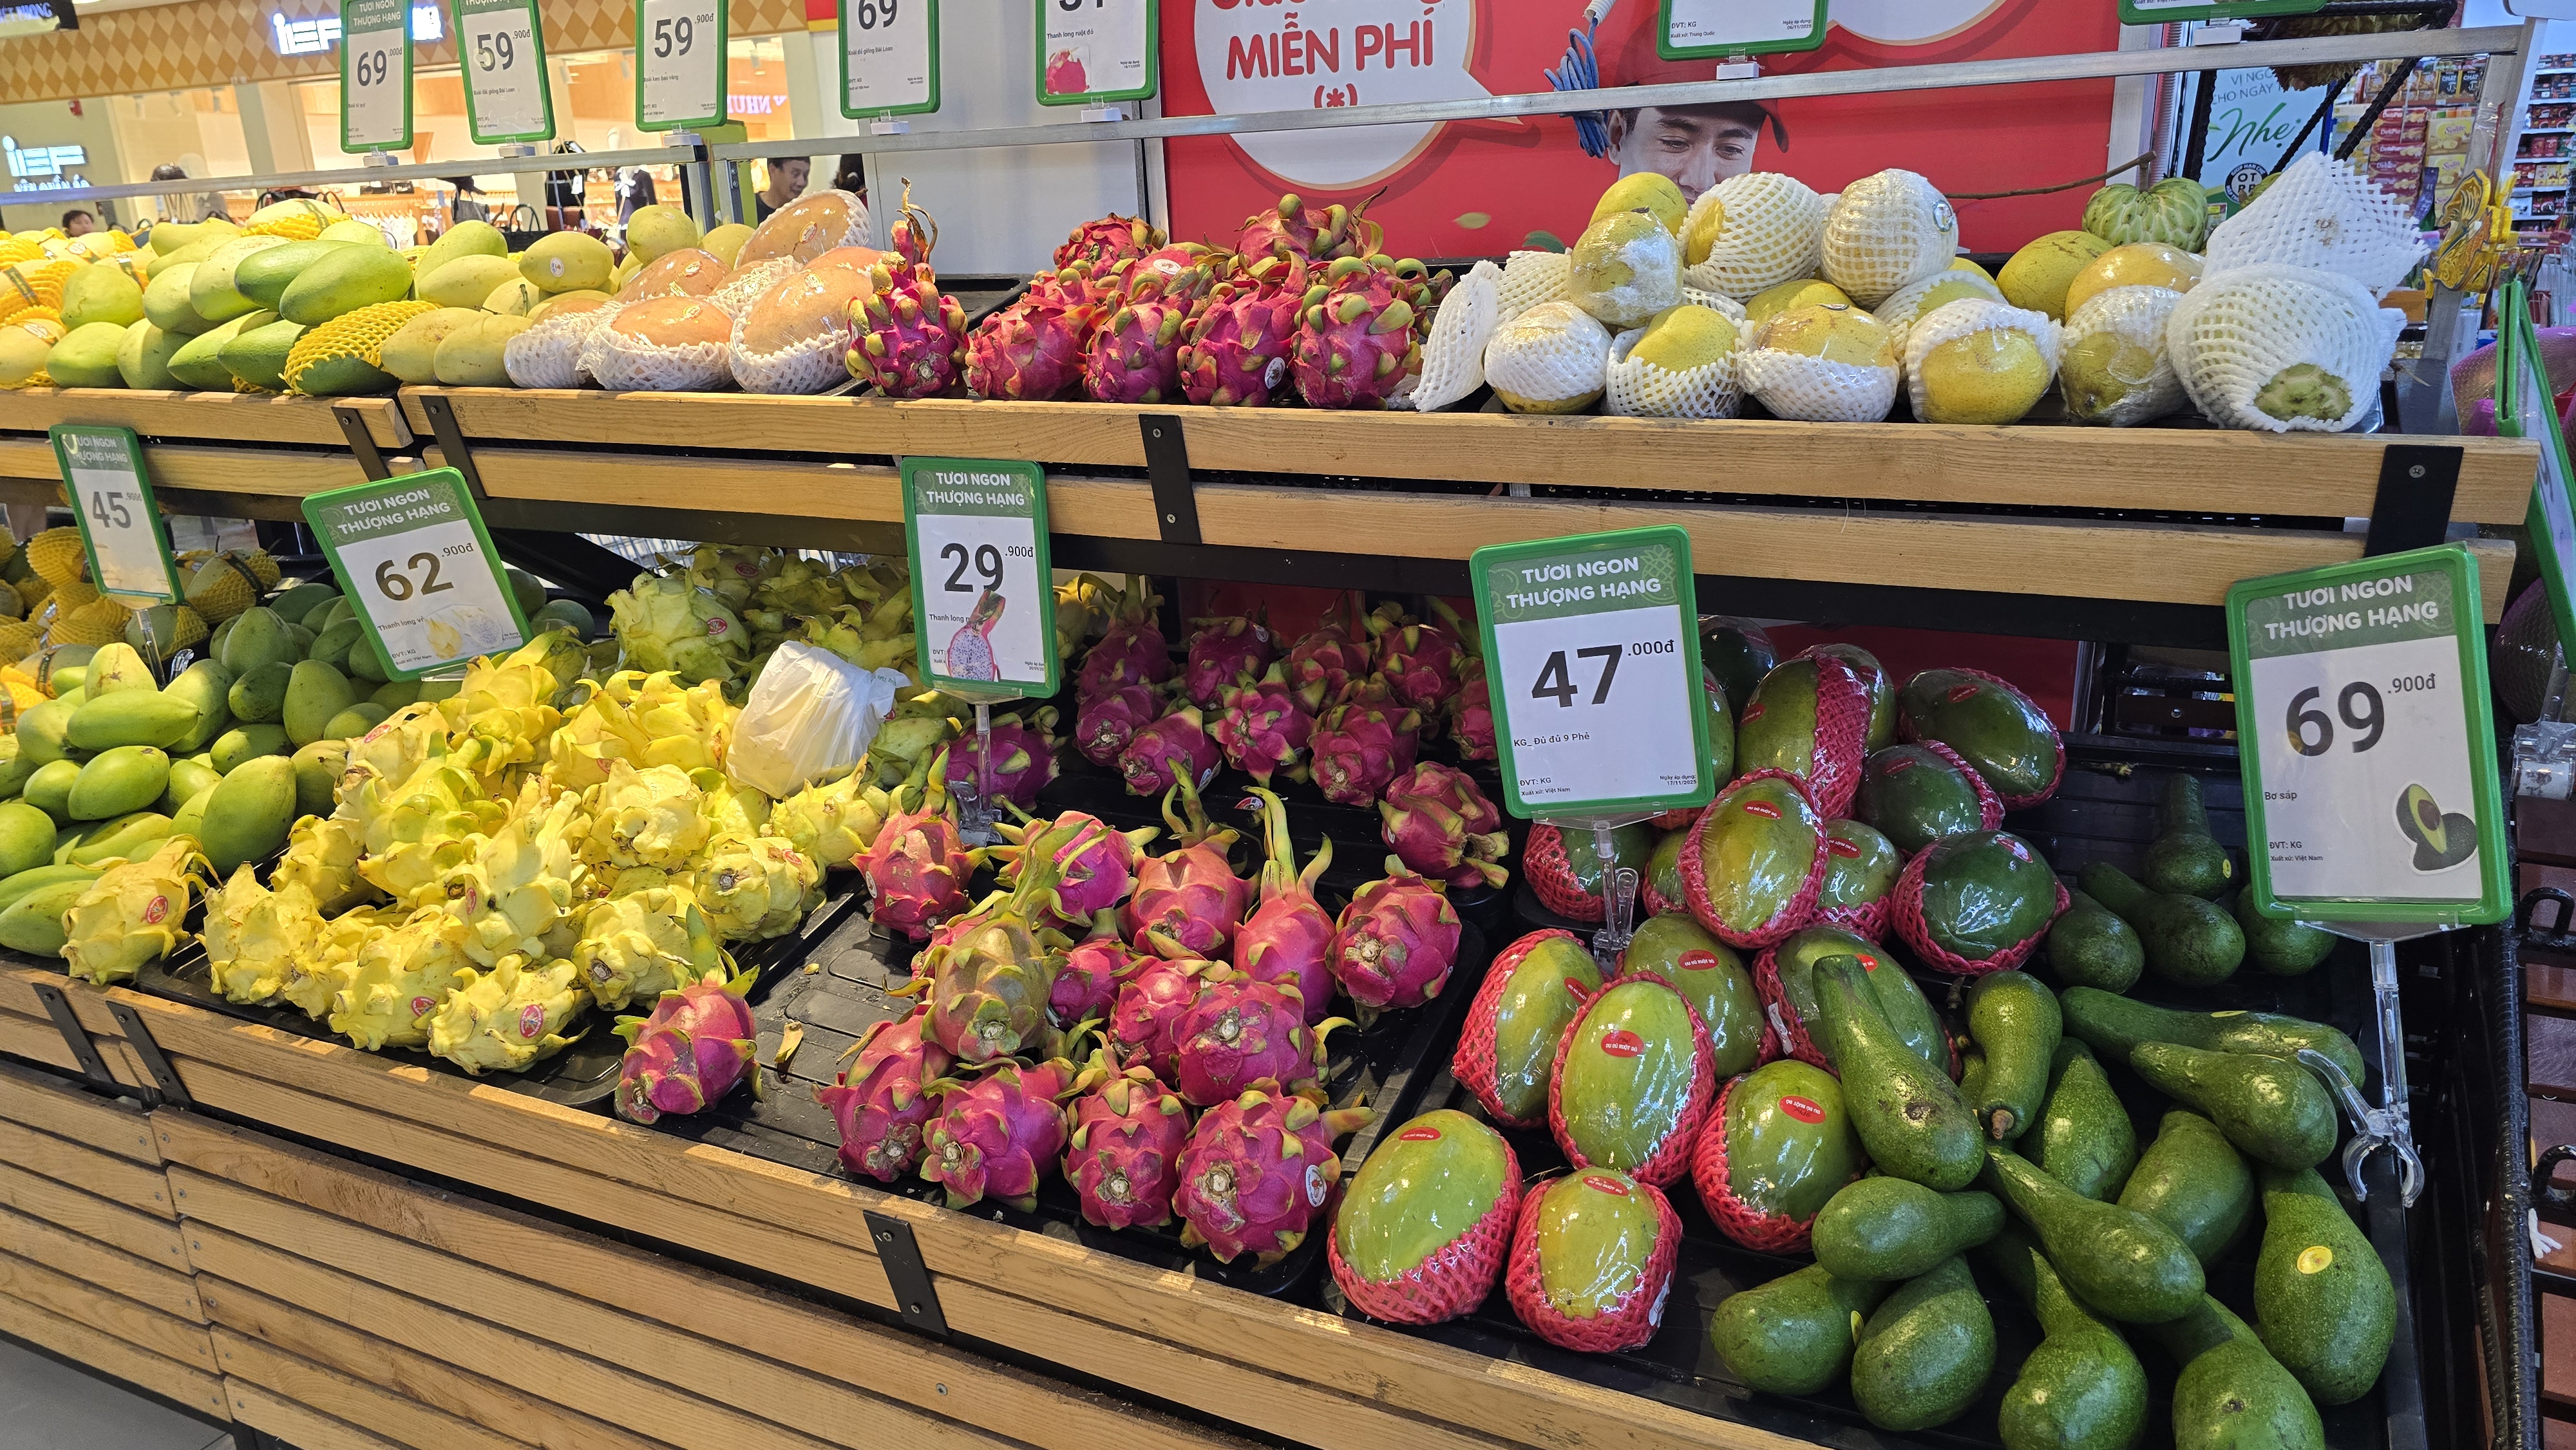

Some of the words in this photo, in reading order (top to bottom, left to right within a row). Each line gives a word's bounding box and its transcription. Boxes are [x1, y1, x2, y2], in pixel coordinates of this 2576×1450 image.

[353, 14, 381, 27] THƯỢNG
[382, 12, 401, 24] HẠNG
[858, 0, 897, 30] 69
[477, 32, 514, 71] 59
[513, 29, 530, 39] .900đ
[654, 17, 693, 57] 59
[694, 13, 714, 24] .900đ
[1227, 12, 1340, 80] MIỄN
[1356, 6, 1434, 71] PHÍ
[357, 50, 387, 86] 69
[2240, 84, 2273, 99] NGÀY
[936, 471, 968, 485] TƯƠI
[971, 473, 1010, 486] NGON
[92, 491, 131, 529] 45
[343, 499, 382, 516] TƯƠI
[383, 489, 430, 509] NGON
[926, 489, 983, 507] THƯỢNG
[986, 493, 1025, 508] HẠNG
[337, 513, 404, 535] THƯỢNG
[406, 502, 451, 520] HẠNG
[375, 552, 454, 601] 62
[442, 542, 474, 558] .900đ
[940, 543, 1003, 592] 29
[1005, 546, 1034, 558] .900đ
[1522, 564, 1571, 583] TƯƠI
[1578, 557, 1639, 578] NGON
[1506, 585, 1595, 608] THƯỢNG
[1601, 578, 1662, 599] HẠNG
[2283, 585, 2334, 610] TƯƠI
[2342, 575, 2412, 601] NGON
[377, 621, 401, 632] Thanh
[402, 618, 417, 626] long
[951, 614, 965, 623] long
[2265, 612, 2362, 640] THƯỢNG
[2368, 601, 2439, 628] HẠNG
[1531, 644, 1623, 708] 47
[1627, 639, 1674, 657] .000đ
[2286, 681, 2385, 757] 69
[2387, 673, 2436, 694] .900đ
[2264, 791, 2277, 800] Bơ
[2280, 791, 2298, 801] sáp
